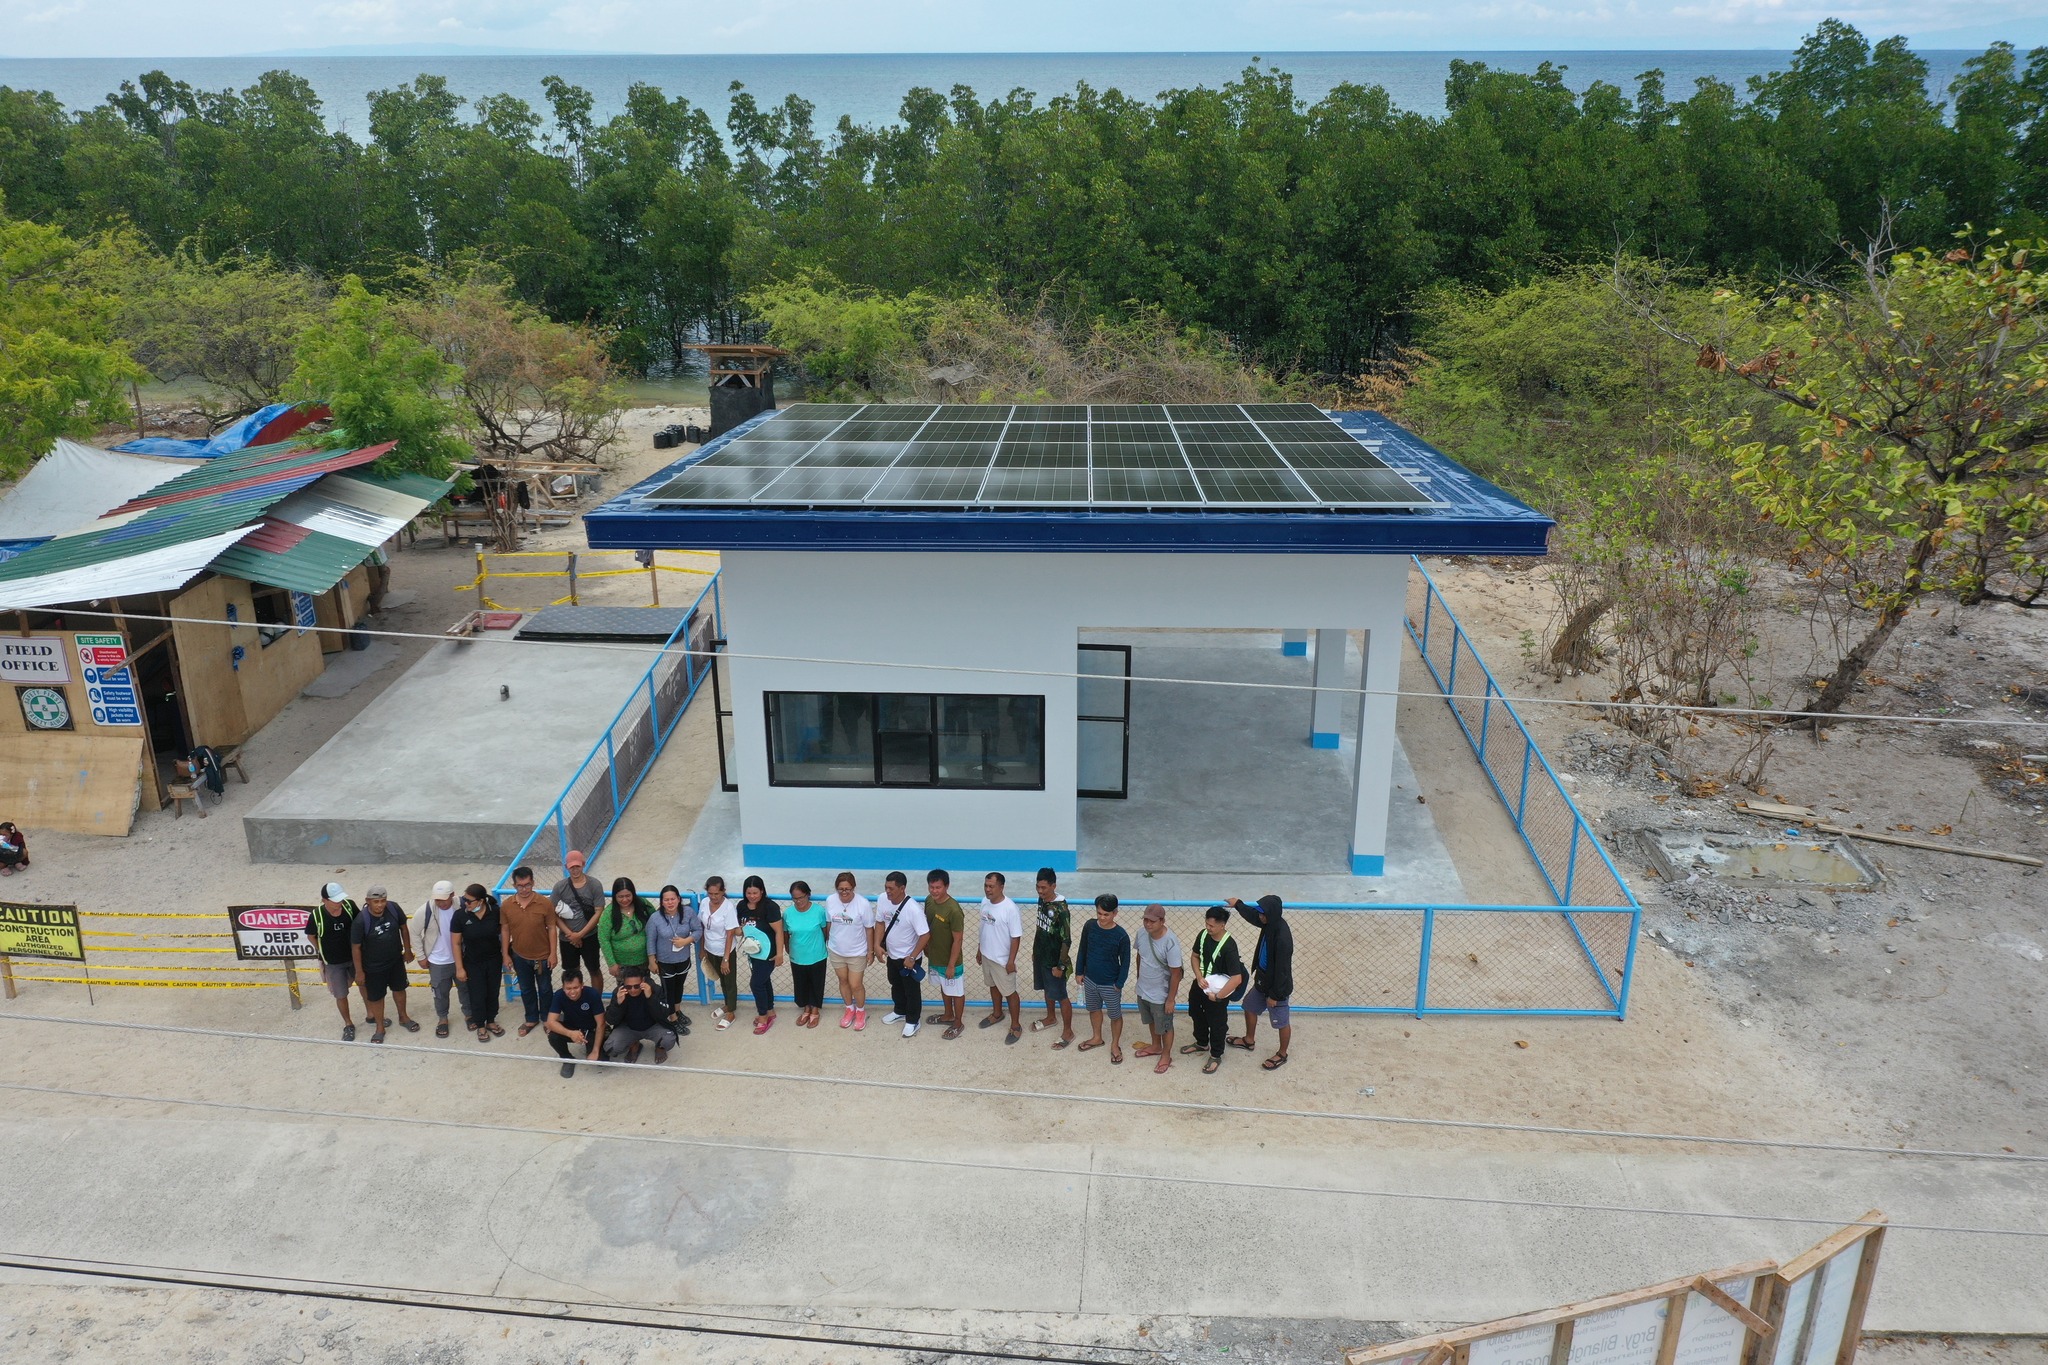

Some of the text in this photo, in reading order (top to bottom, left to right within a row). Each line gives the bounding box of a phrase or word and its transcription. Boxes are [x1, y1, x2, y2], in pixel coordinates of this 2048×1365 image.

[4, 645, 53, 656] FIELD
[1, 660, 60, 671] OFFICE
[24, 690, 63, 704] SAFETY FIRST
[42, 704, 48, 712] &
[27, 710, 66, 726] SAFETY ALWAYS
[0, 924, 74, 937] CONSTRUCTION
[26, 935, 51, 944] AREA
[263, 932, 299, 943] DEEP
[8, 947, 51, 955] PERSONNEL
[16, 942, 63, 951] AUTHORIZED
[242, 945, 319, 956] EXCAVATIO
